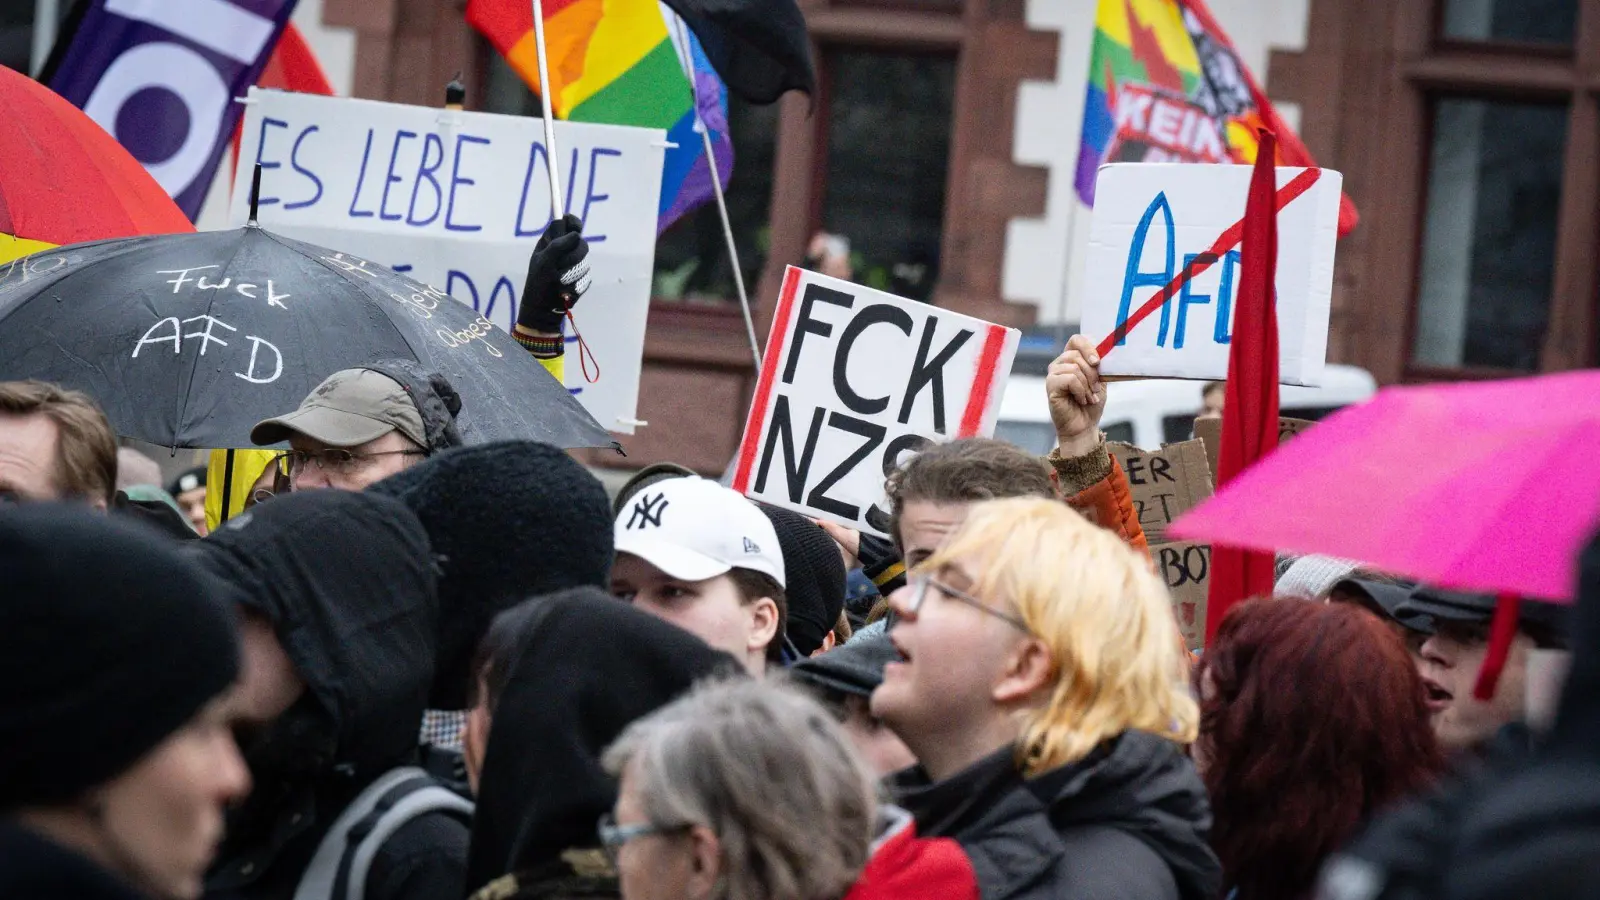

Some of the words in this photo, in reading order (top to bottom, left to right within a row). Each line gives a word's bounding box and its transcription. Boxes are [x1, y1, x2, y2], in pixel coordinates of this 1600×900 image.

[249, 117, 323, 210] ES
[349, 127, 491, 231] LEBE
[515, 141, 622, 241] DIE
[156, 264, 291, 309] Fuck
[132, 315, 283, 384] AFD
[782, 283, 975, 435] FCK
